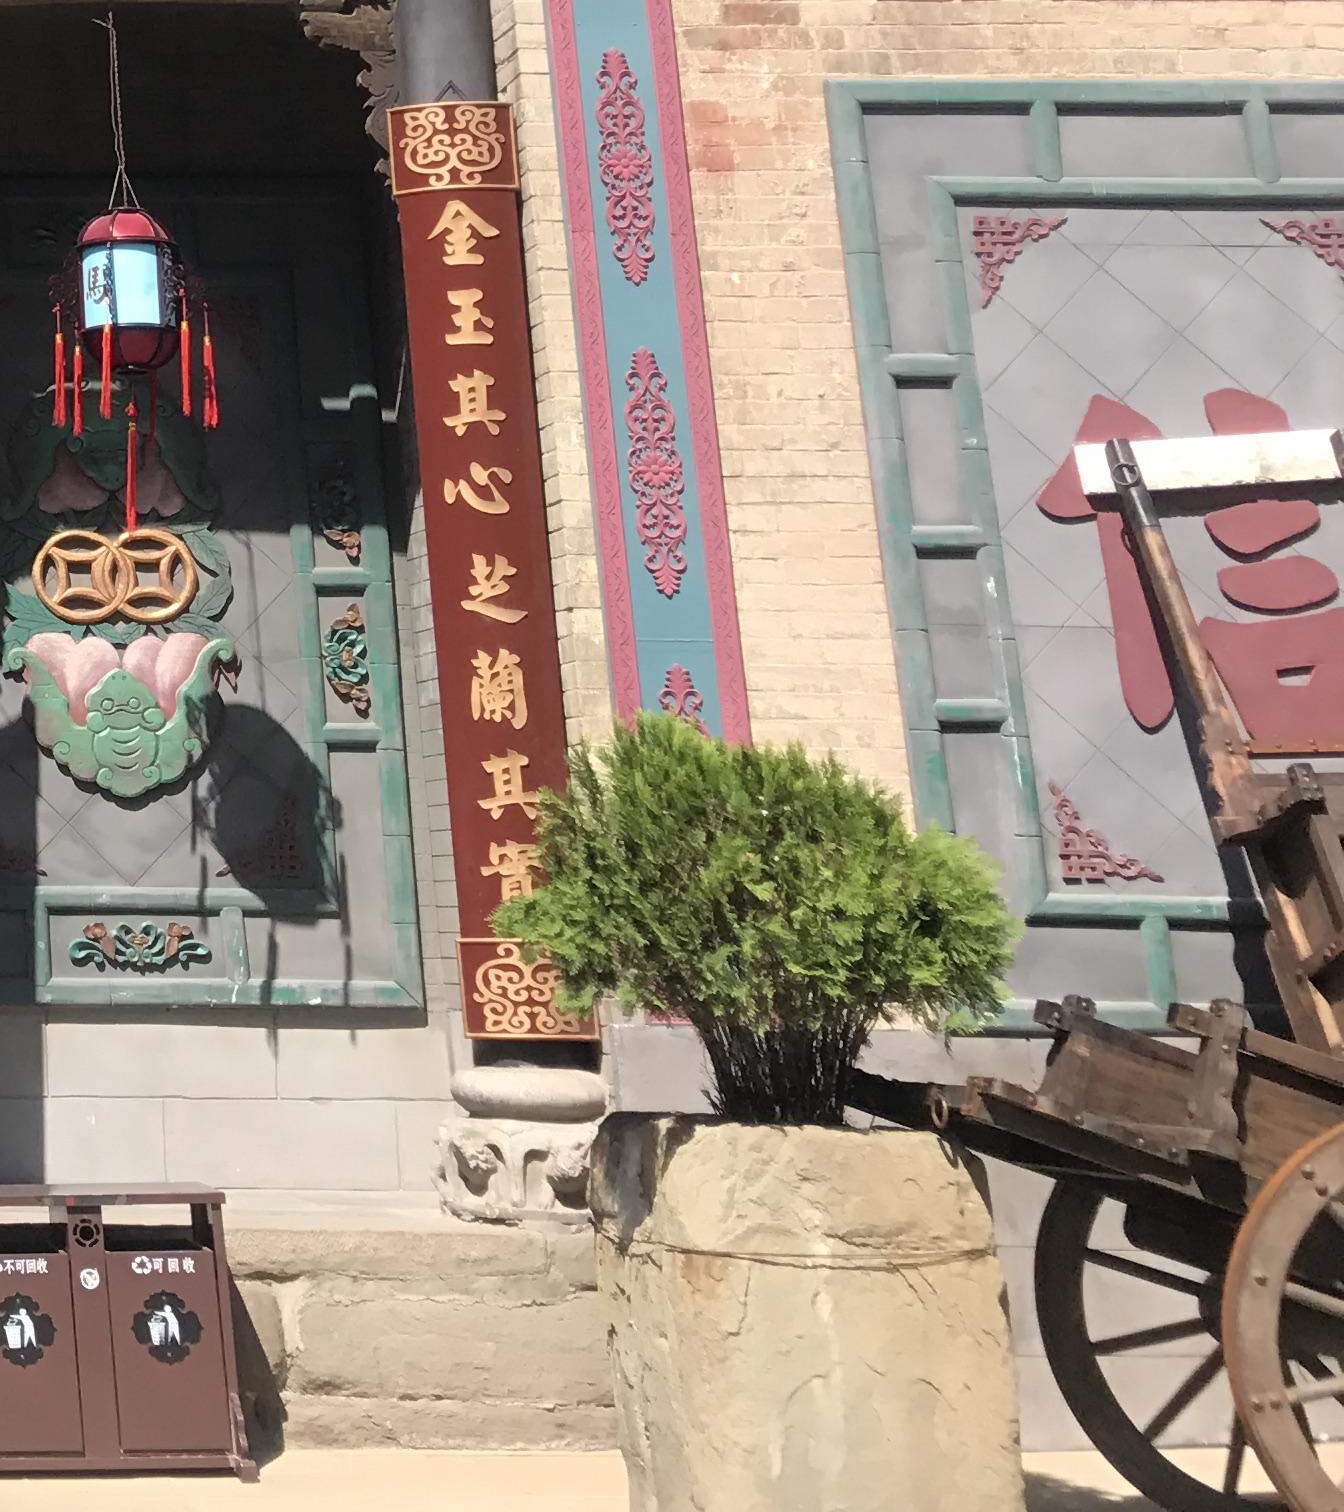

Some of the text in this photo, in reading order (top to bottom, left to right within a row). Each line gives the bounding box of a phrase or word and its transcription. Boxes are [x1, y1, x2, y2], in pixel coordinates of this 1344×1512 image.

[3, 1258, 49, 1275] 不可回收
[152, 1256, 196, 1274] 可回收
